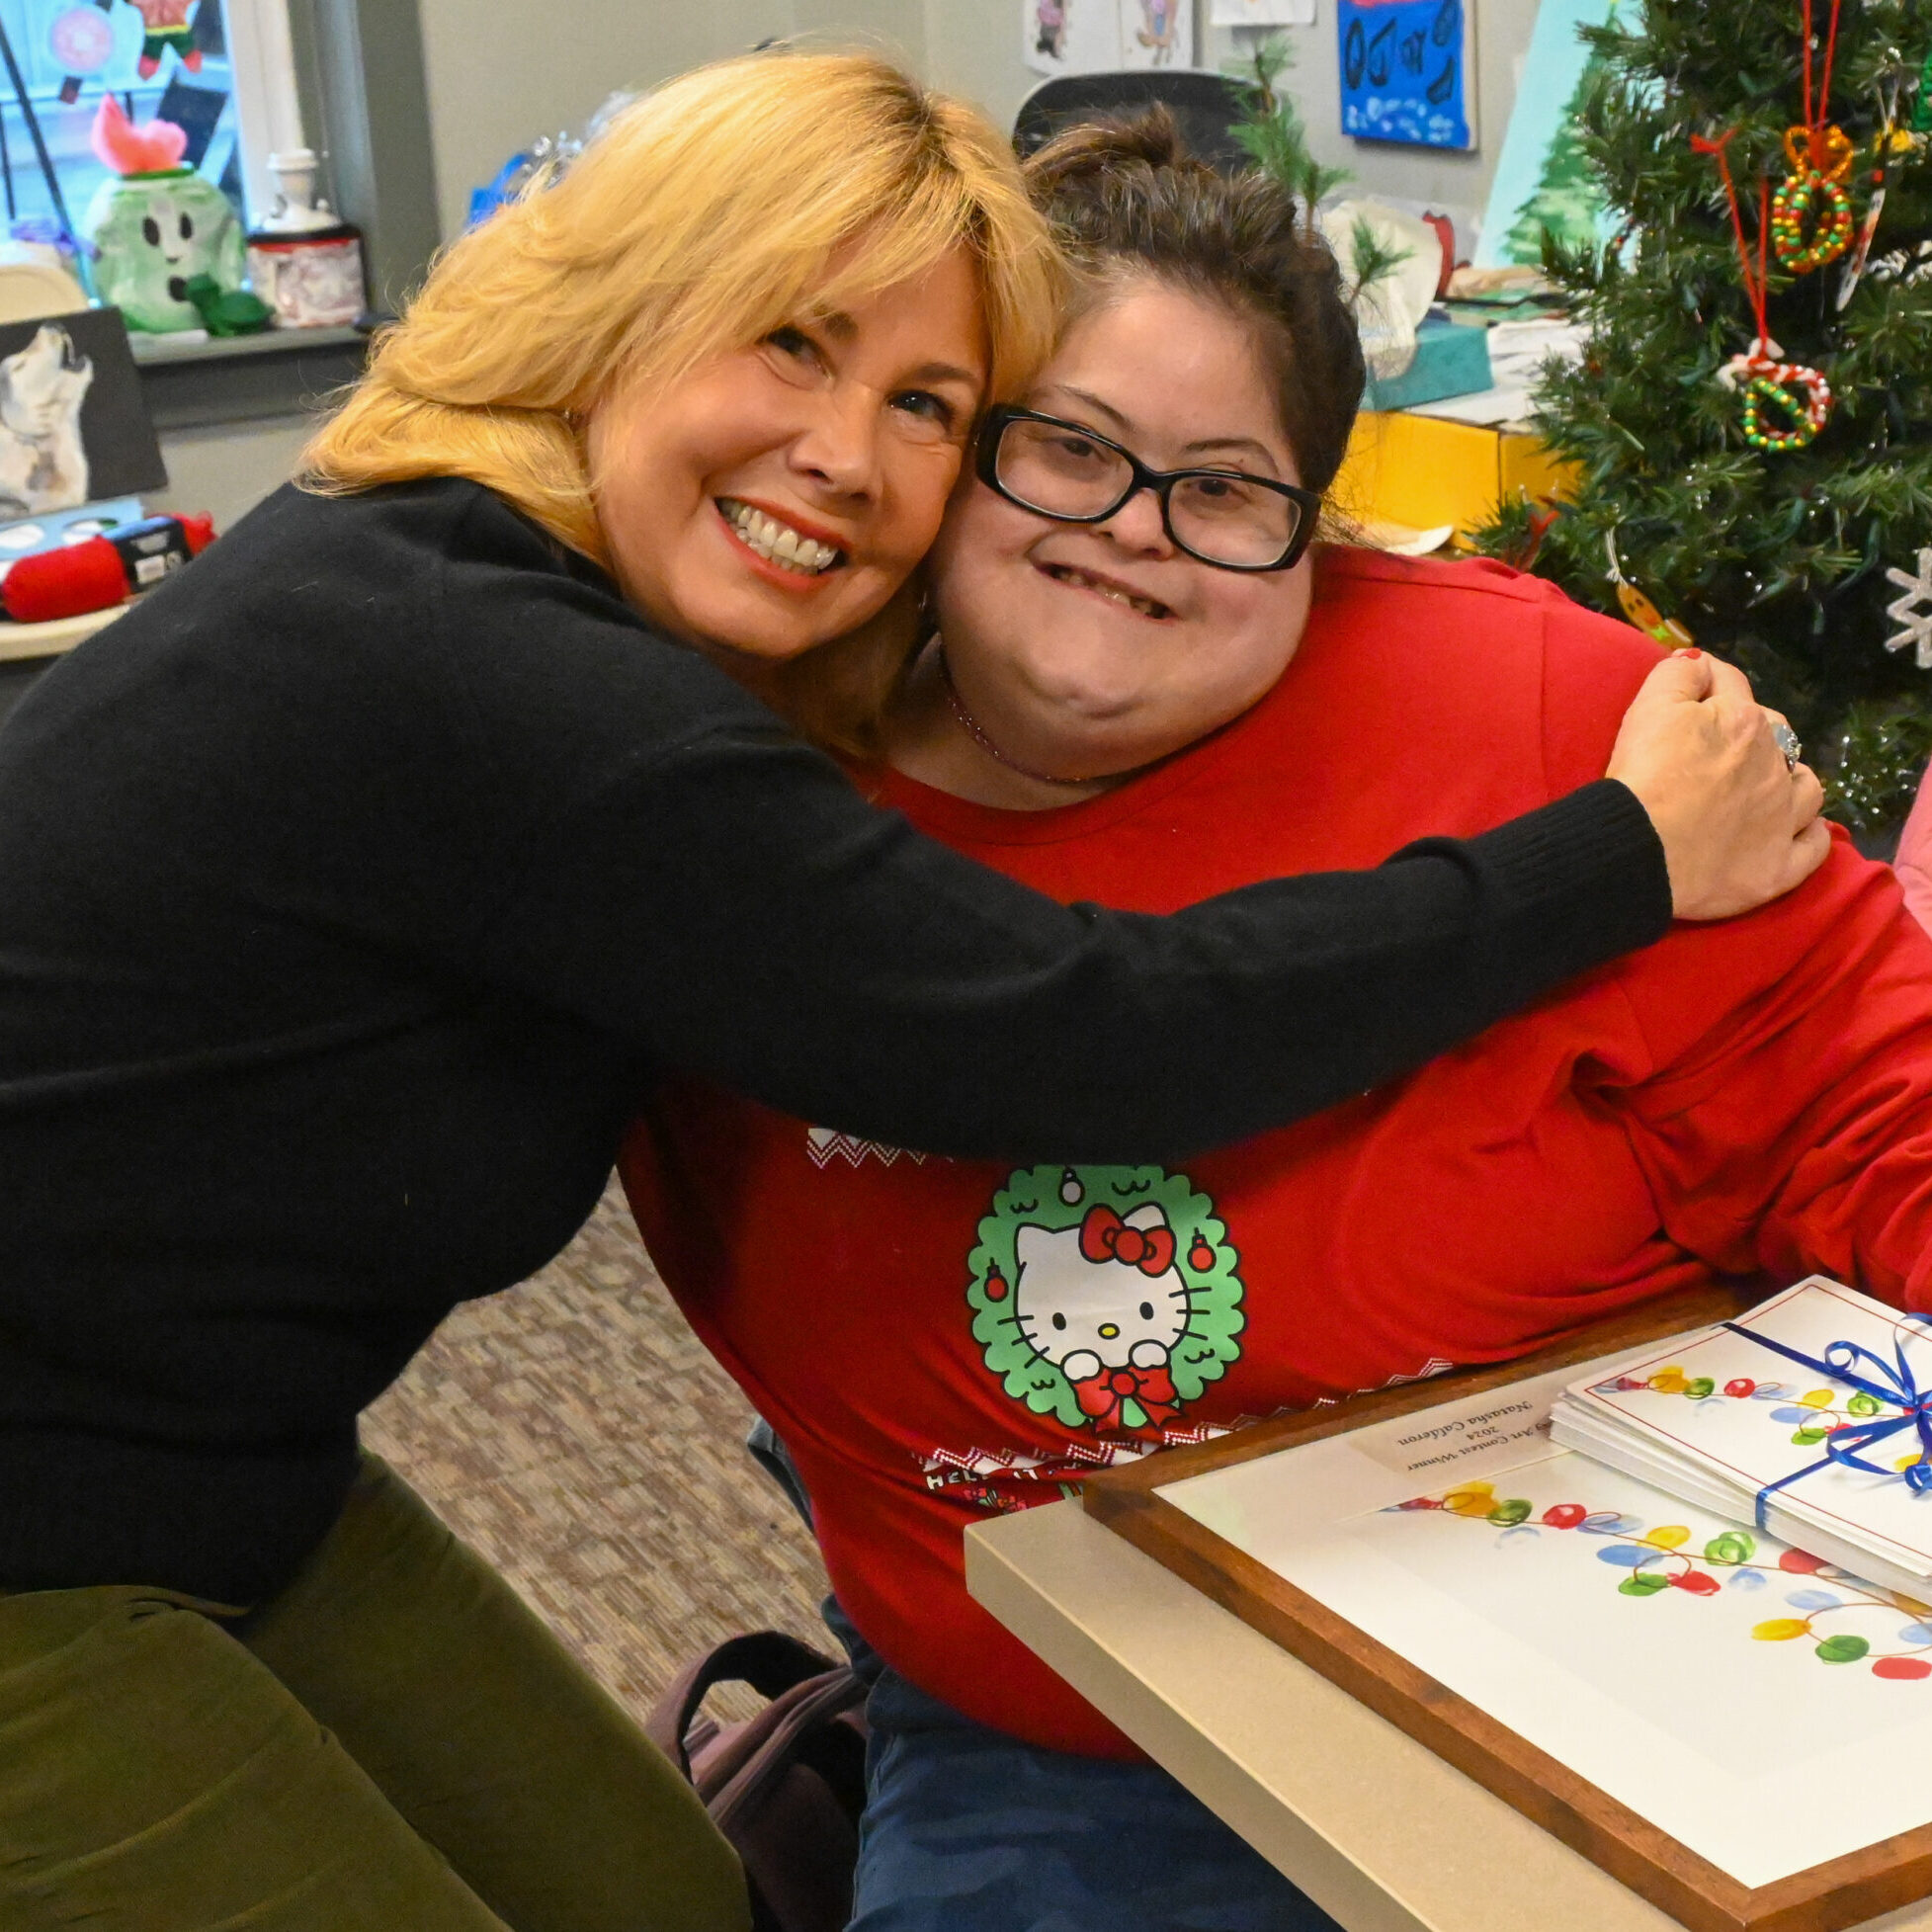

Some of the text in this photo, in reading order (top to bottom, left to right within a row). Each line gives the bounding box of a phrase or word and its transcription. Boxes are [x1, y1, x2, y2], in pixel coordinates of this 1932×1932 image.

[1398, 1401, 1533, 1446] Natasha Calderon
[1467, 1426, 1500, 1441] 2024
[1459, 1436, 1508, 1456] Contest
[1407, 1453, 1458, 1471] Winner
